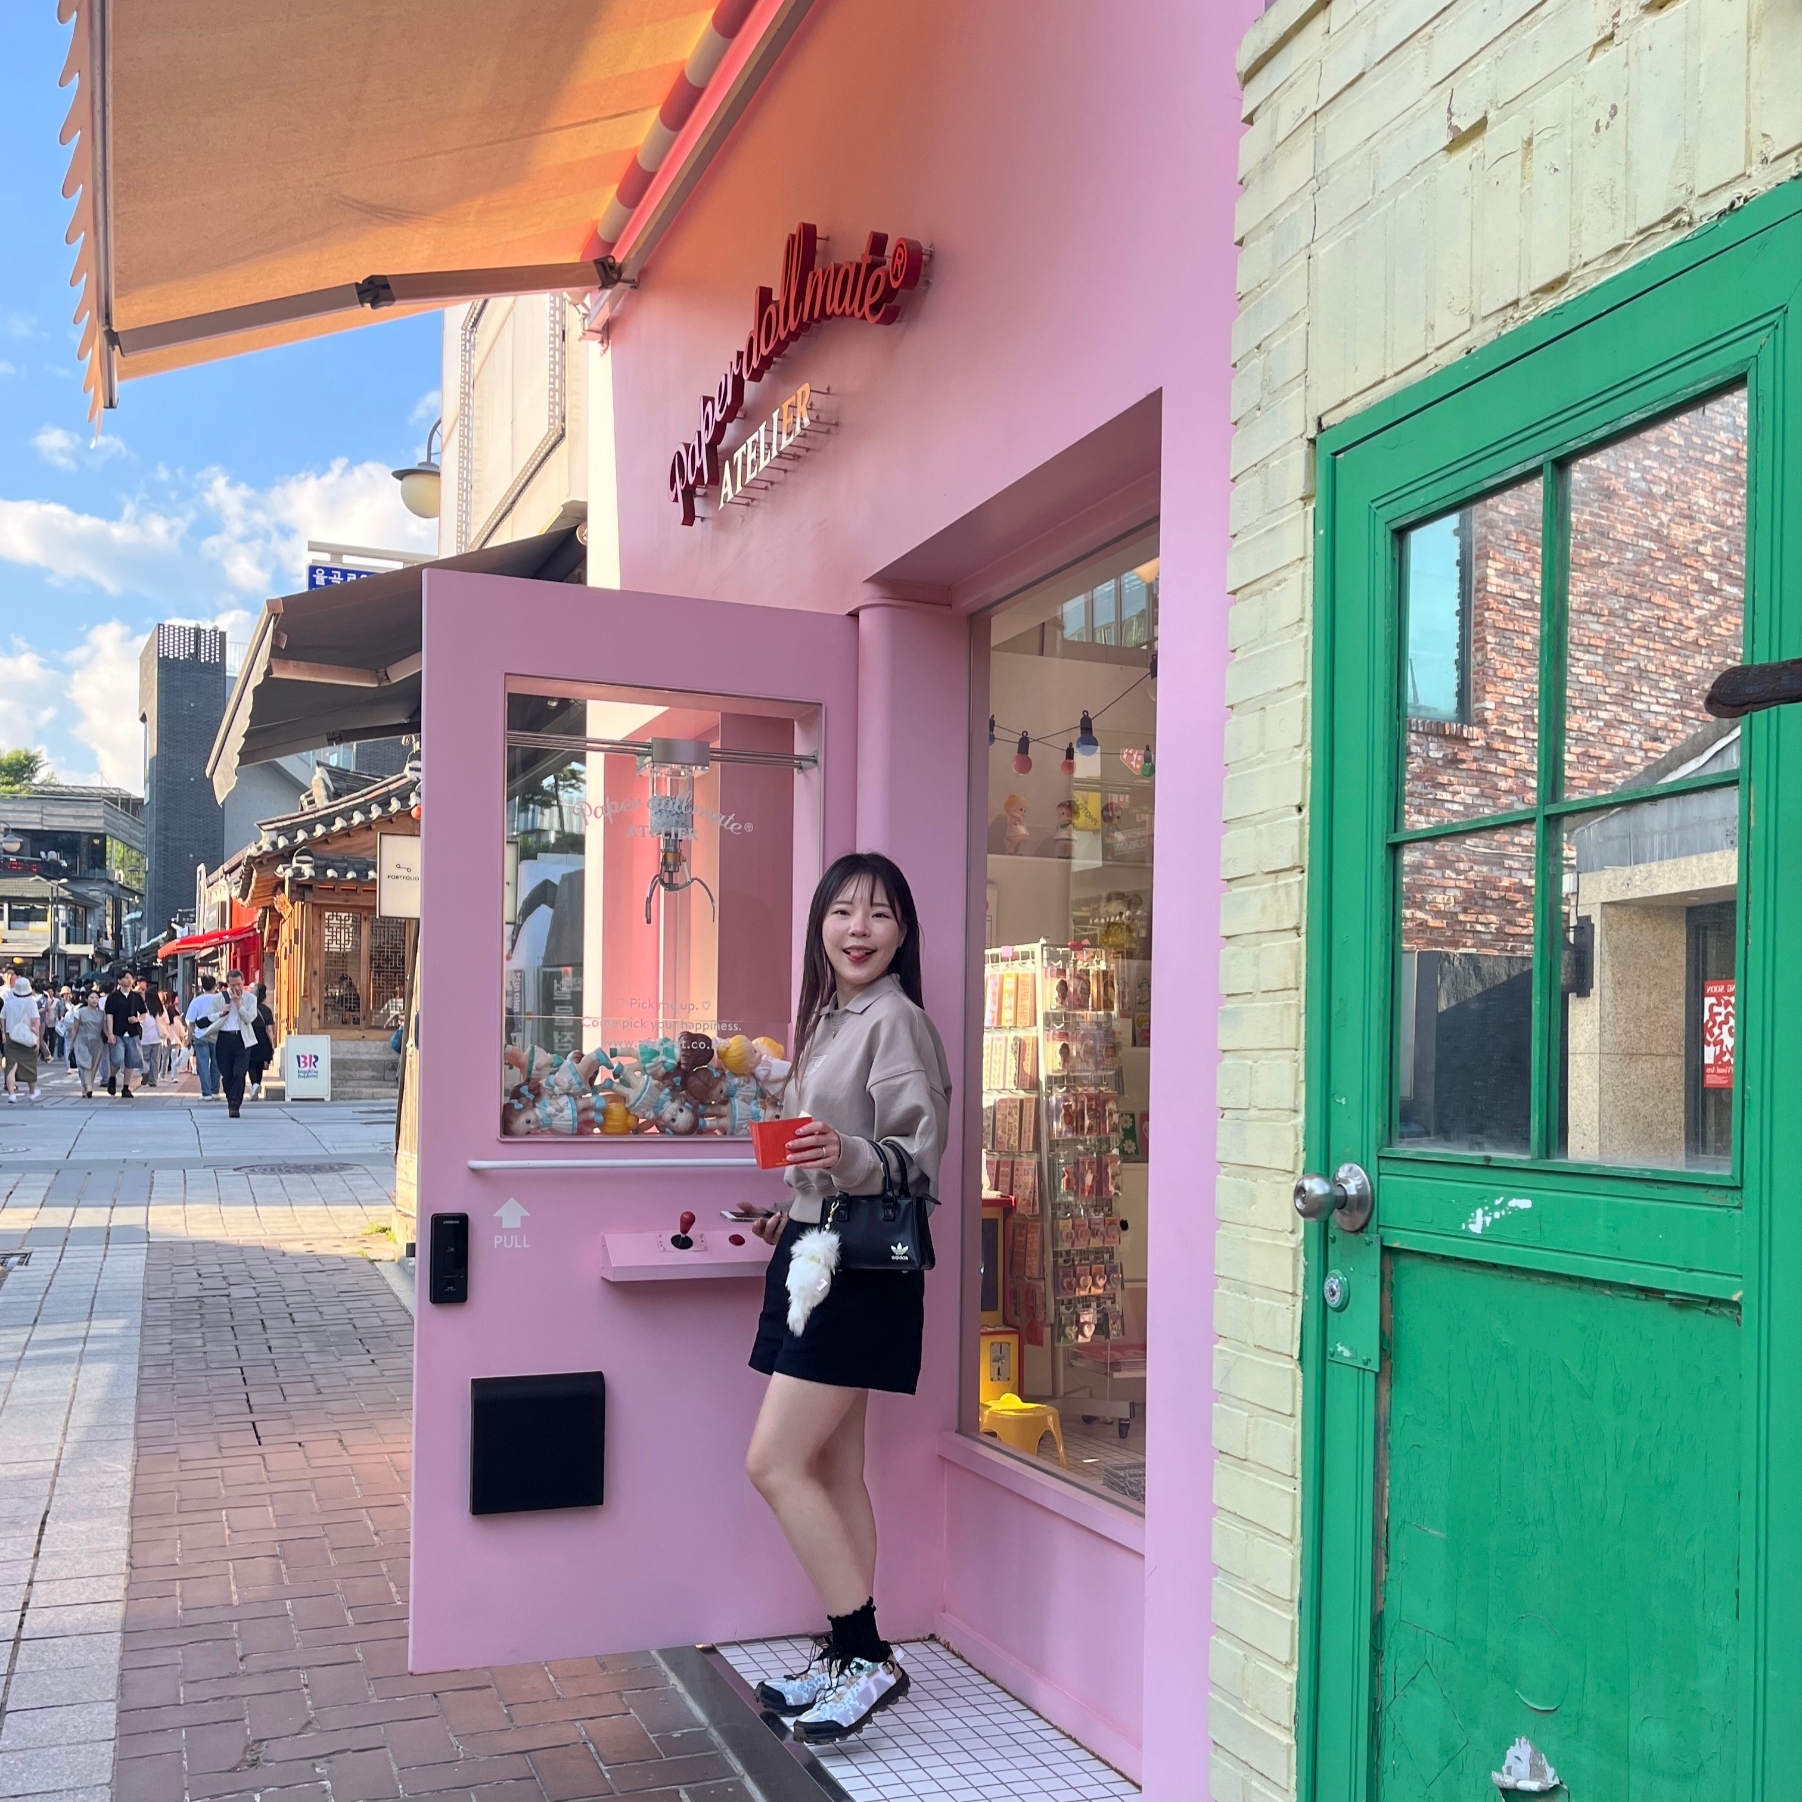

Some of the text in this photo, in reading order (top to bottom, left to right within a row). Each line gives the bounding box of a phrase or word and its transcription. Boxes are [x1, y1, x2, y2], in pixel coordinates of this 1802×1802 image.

[668, 350, 744, 526] Paper
[742, 222, 817, 382] doll
[718, 383, 812, 510] ATELIER
[573, 796, 643, 826] Paper
[626, 826, 699, 841] ATELIER
[629, 998, 699, 1014] Pick me up.
[582, 1016, 742, 1033] Come pick your happiness.
[295, 1054, 319, 1069] BR
[493, 1235, 531, 1248] PULL
